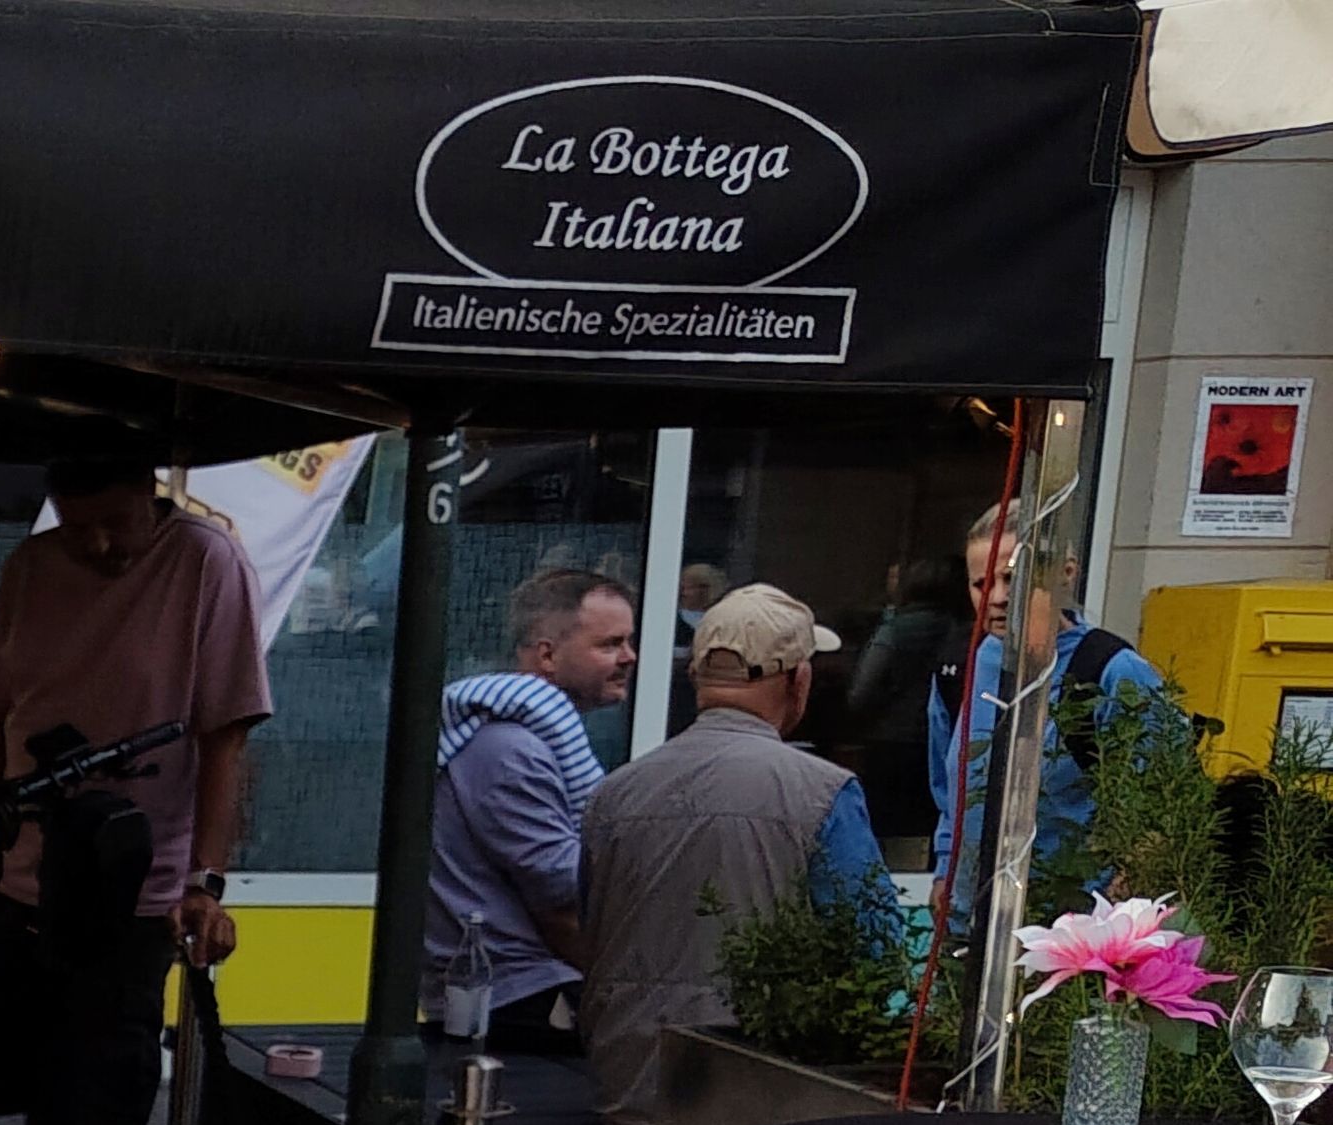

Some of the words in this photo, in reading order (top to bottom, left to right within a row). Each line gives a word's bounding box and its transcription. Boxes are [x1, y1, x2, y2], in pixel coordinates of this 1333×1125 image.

[500, 124, 575, 174] La
[589, 126, 790, 195] Bottega
[532, 196, 745, 253] Italiana
[413, 295, 602, 335] Italienische
[610, 302, 816, 344] Spezialitäten
[1207, 385, 1270, 397] MODERN
[1274, 386, 1306, 398] ART
